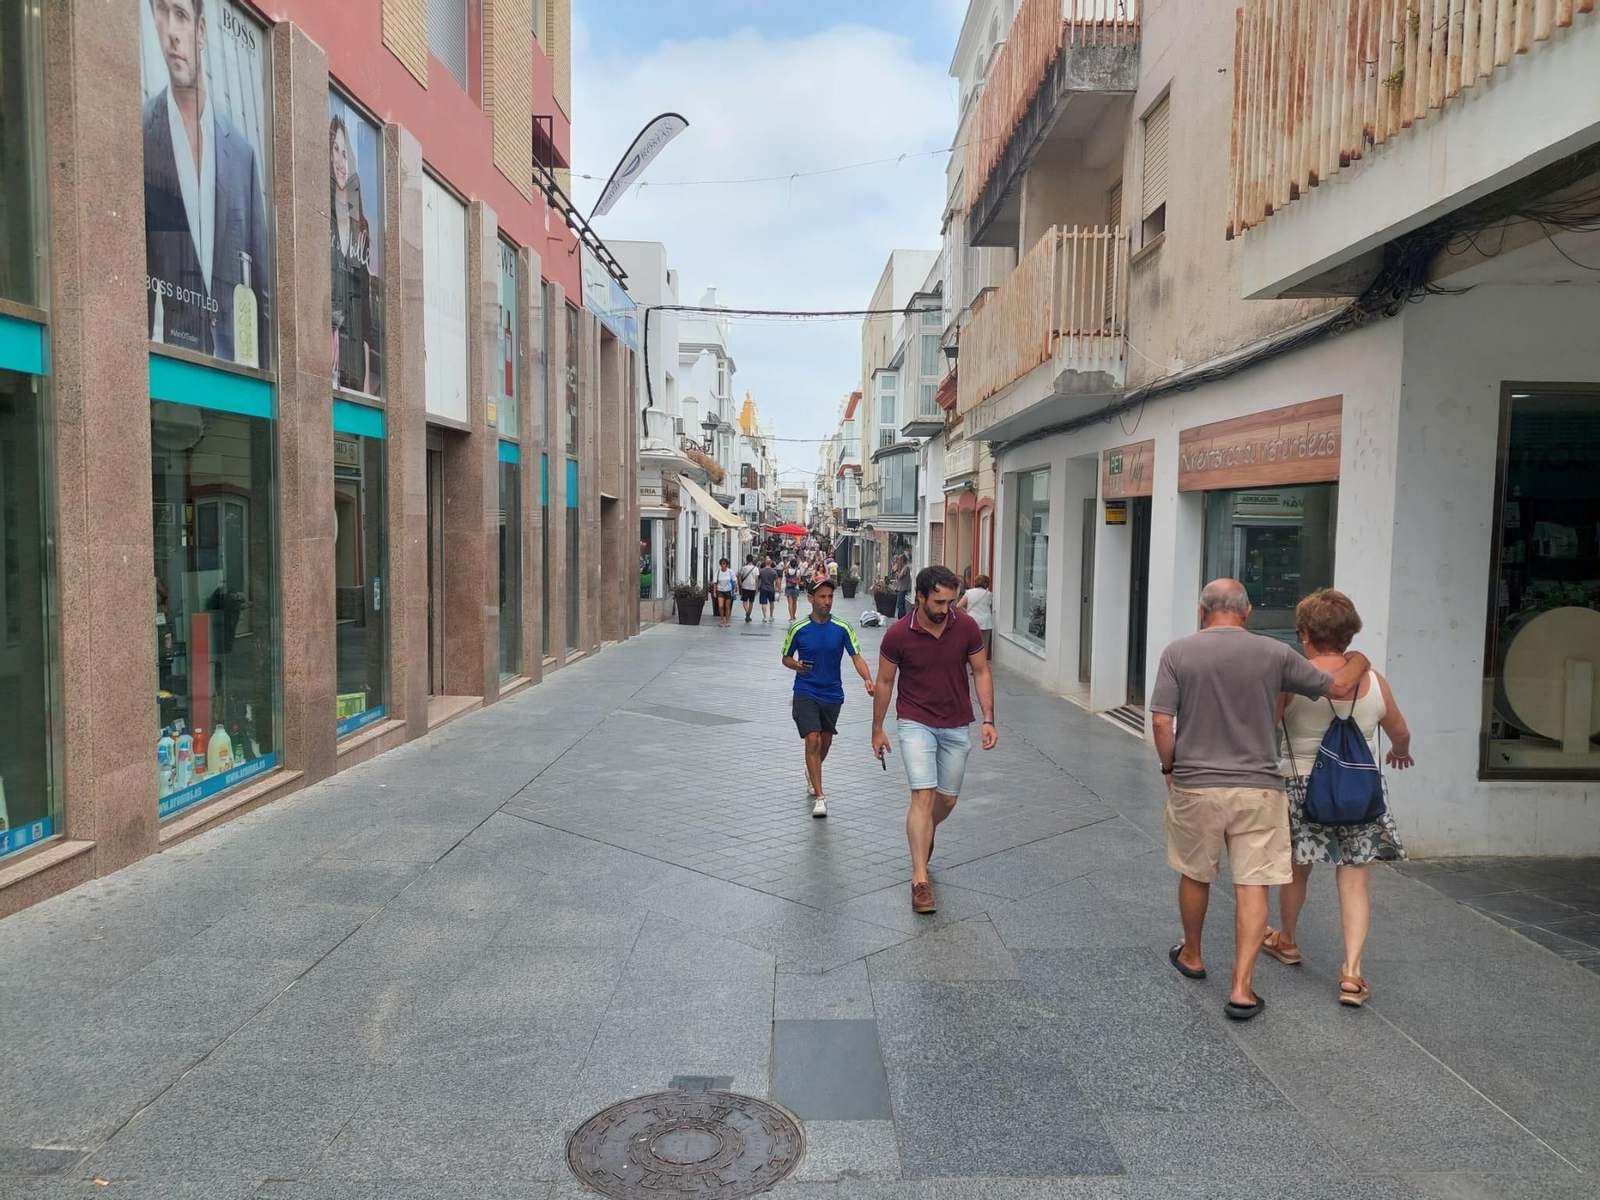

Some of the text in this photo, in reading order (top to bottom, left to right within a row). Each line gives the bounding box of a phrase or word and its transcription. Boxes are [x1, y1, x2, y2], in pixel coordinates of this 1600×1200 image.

[222, 7, 256, 50] BOSS
[146, 275, 219, 313] BOSS BOTTLED
[1260, 422, 1337, 464] naturaleza
